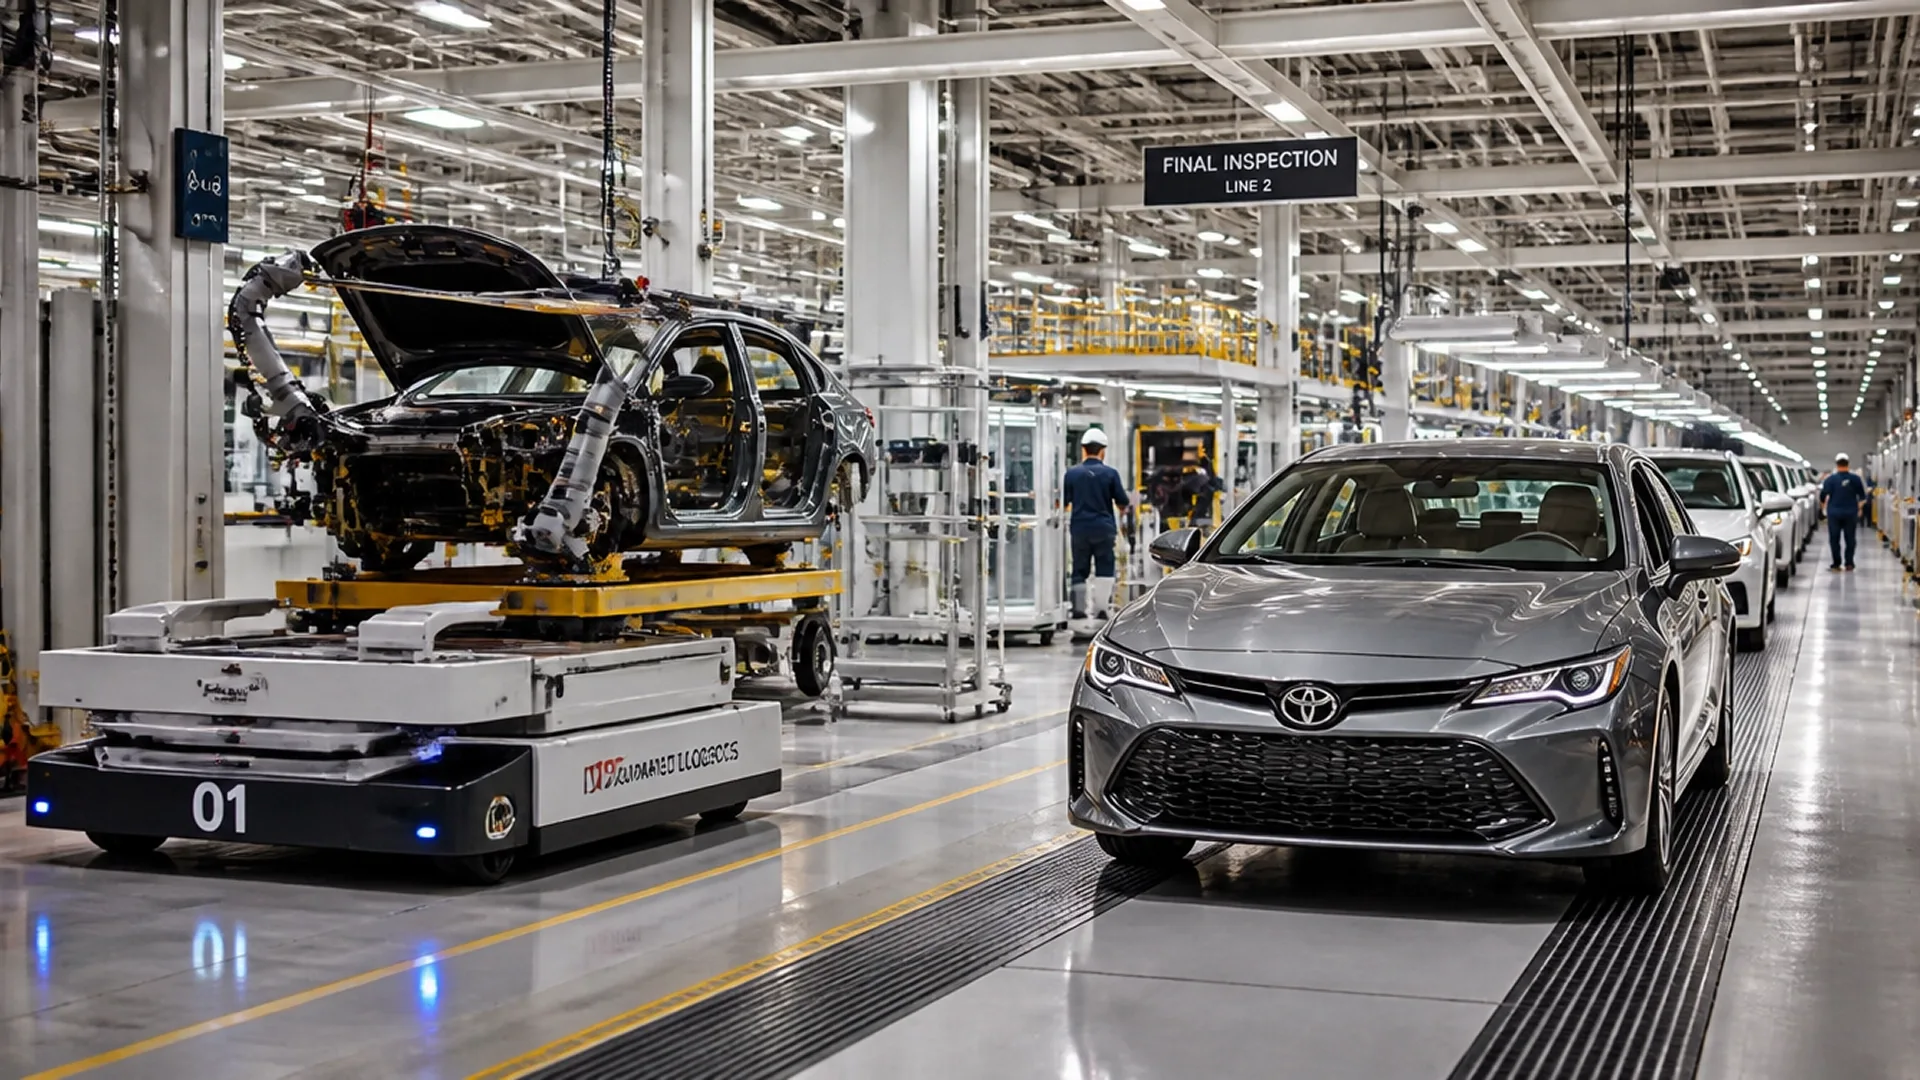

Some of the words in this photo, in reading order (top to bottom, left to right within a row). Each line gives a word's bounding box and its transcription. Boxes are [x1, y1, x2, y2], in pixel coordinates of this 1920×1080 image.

[1163, 155, 1217, 173] FINAL
[1224, 149, 1338, 170] INSPECTION
[1226, 179, 1258, 193] LINE
[1263, 178, 1272, 192] 2
[193, 781, 246, 833] 01
